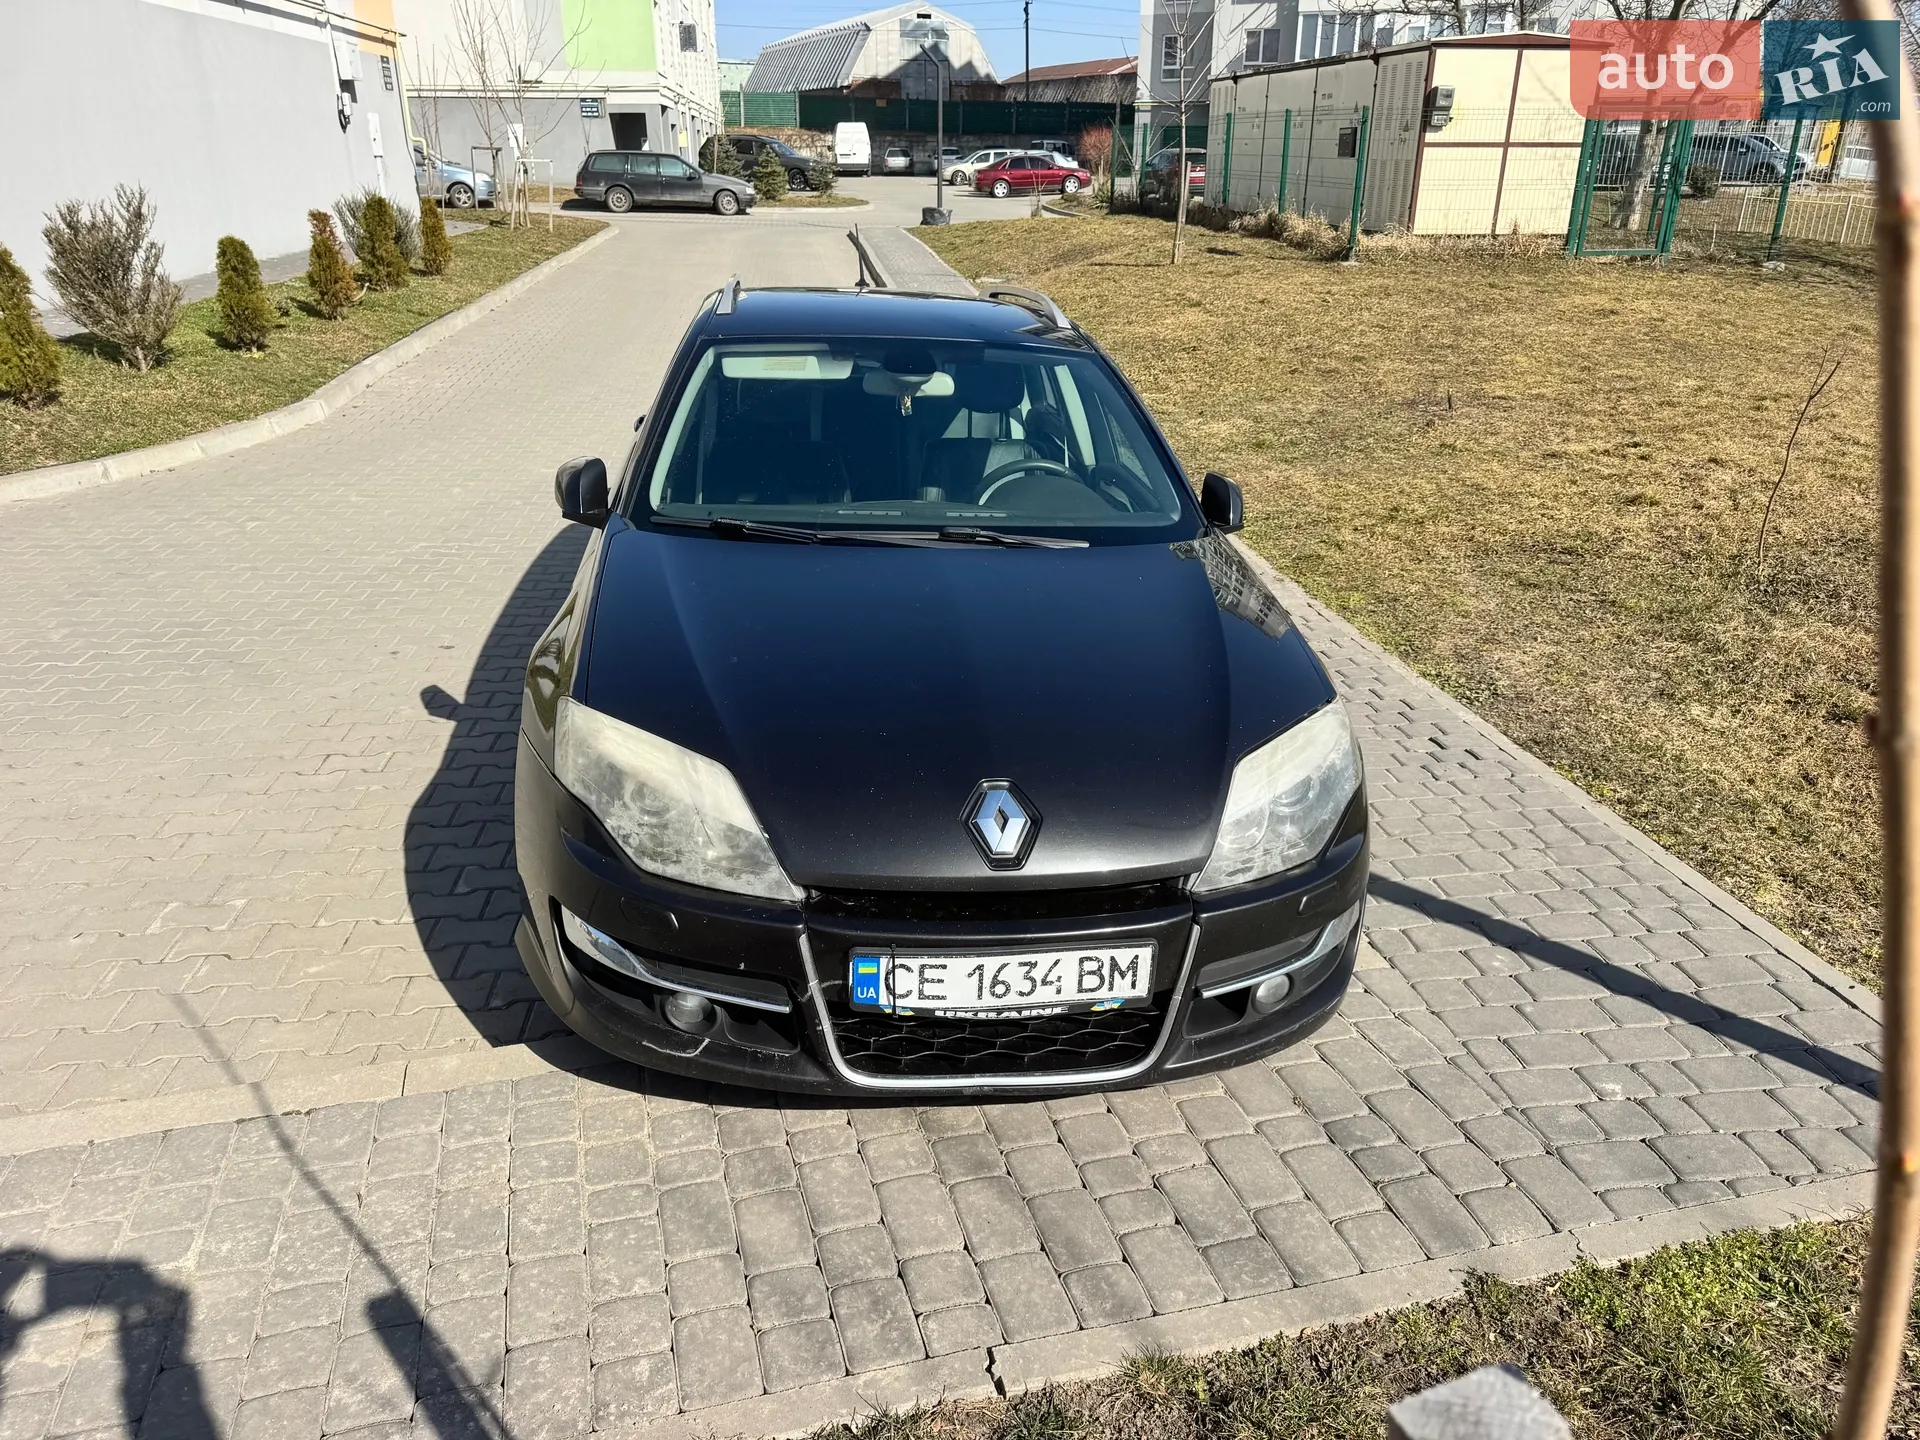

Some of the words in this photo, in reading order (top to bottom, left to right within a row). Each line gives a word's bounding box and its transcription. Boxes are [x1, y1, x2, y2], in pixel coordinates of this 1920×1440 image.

[884, 963, 948, 1000] CE
[966, 958, 1063, 1000] 1634
[1077, 954, 1139, 994] BM
[857, 986, 877, 999] UA
[934, 1005, 1070, 1020] UKRAINE
